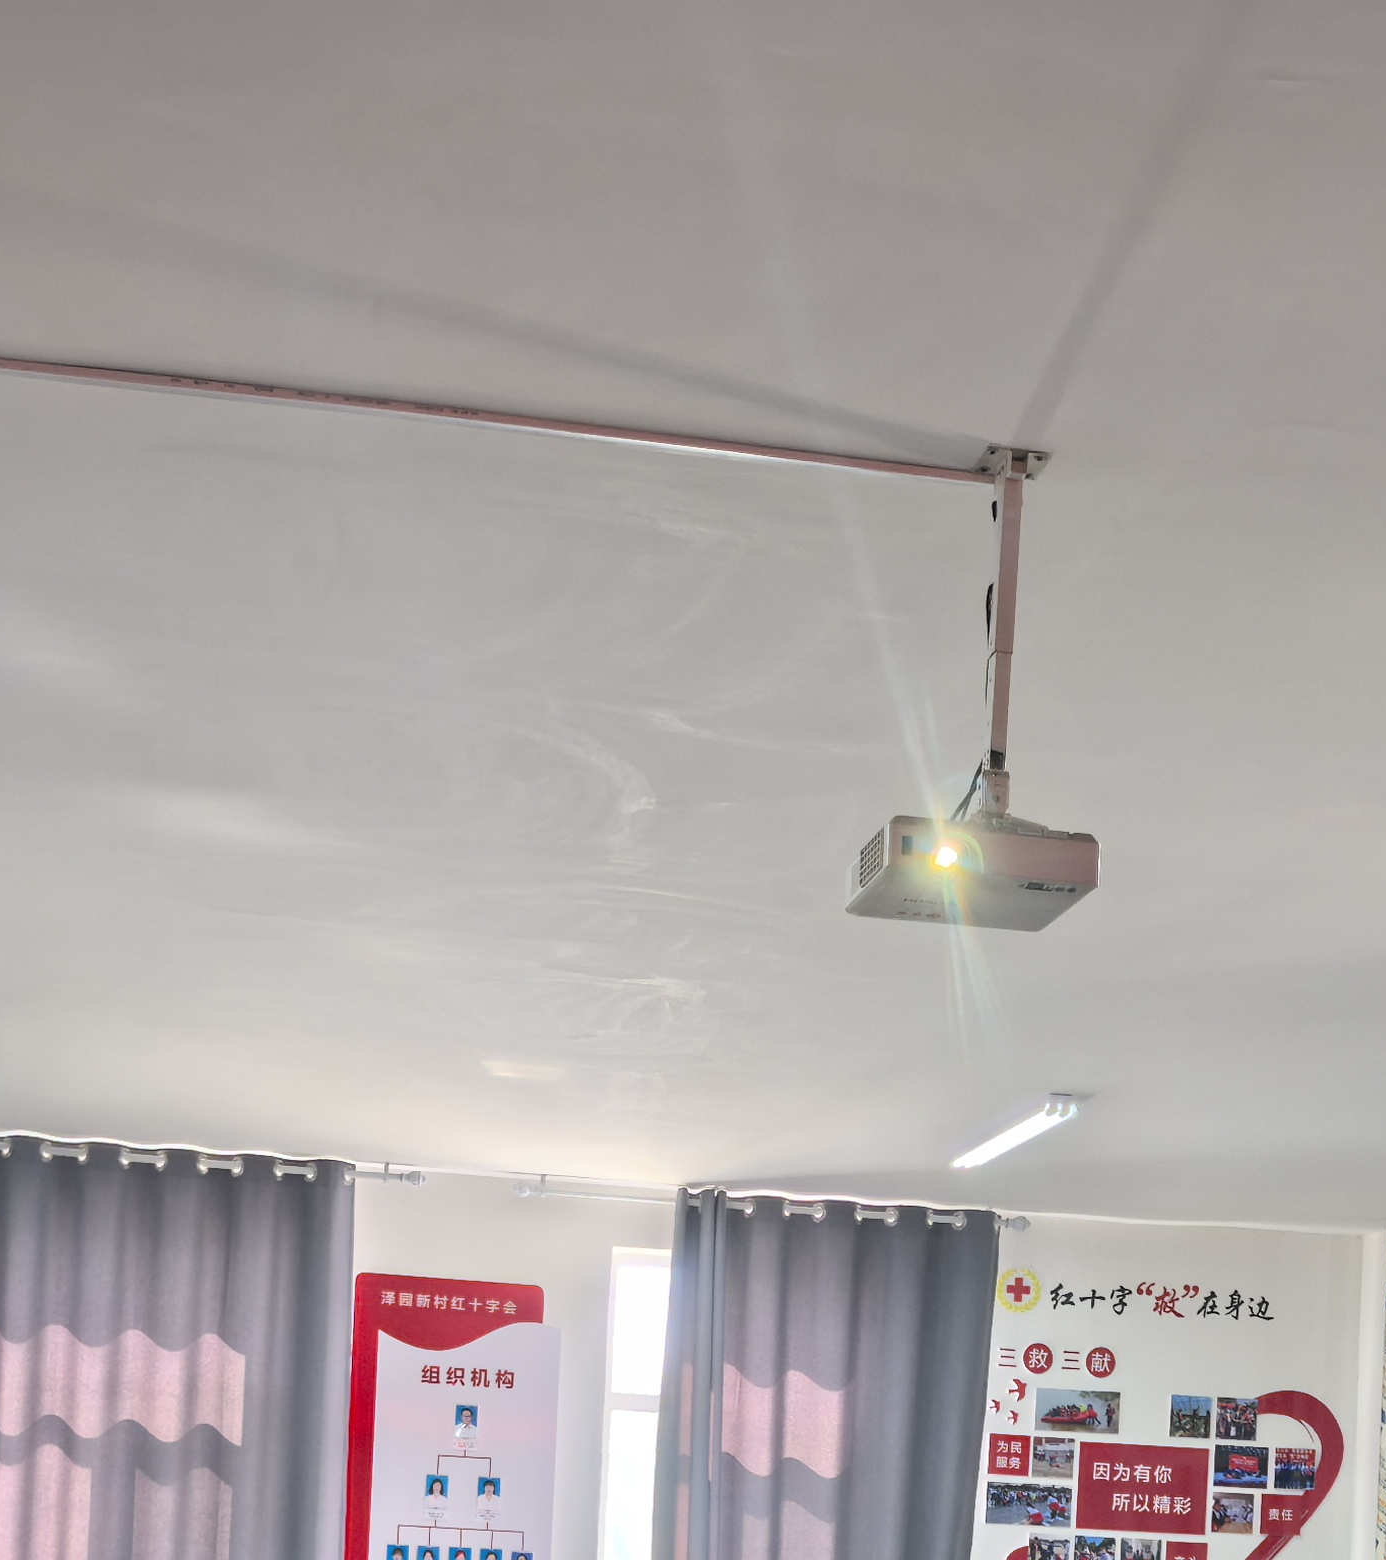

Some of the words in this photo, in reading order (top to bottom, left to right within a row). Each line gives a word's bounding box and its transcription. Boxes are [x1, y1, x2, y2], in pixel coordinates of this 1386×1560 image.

[380, 1290, 518, 1315] 泽园新村红十字会
[421, 1364, 516, 1390] 组织机构
[996, 1441, 1022, 1455] 为民
[996, 1455, 1022, 1470] 服务
[1092, 1461, 1173, 1484] 因为有你
[1111, 1493, 1192, 1516] 所以精彩
[1268, 1507, 1293, 1522] 责任
